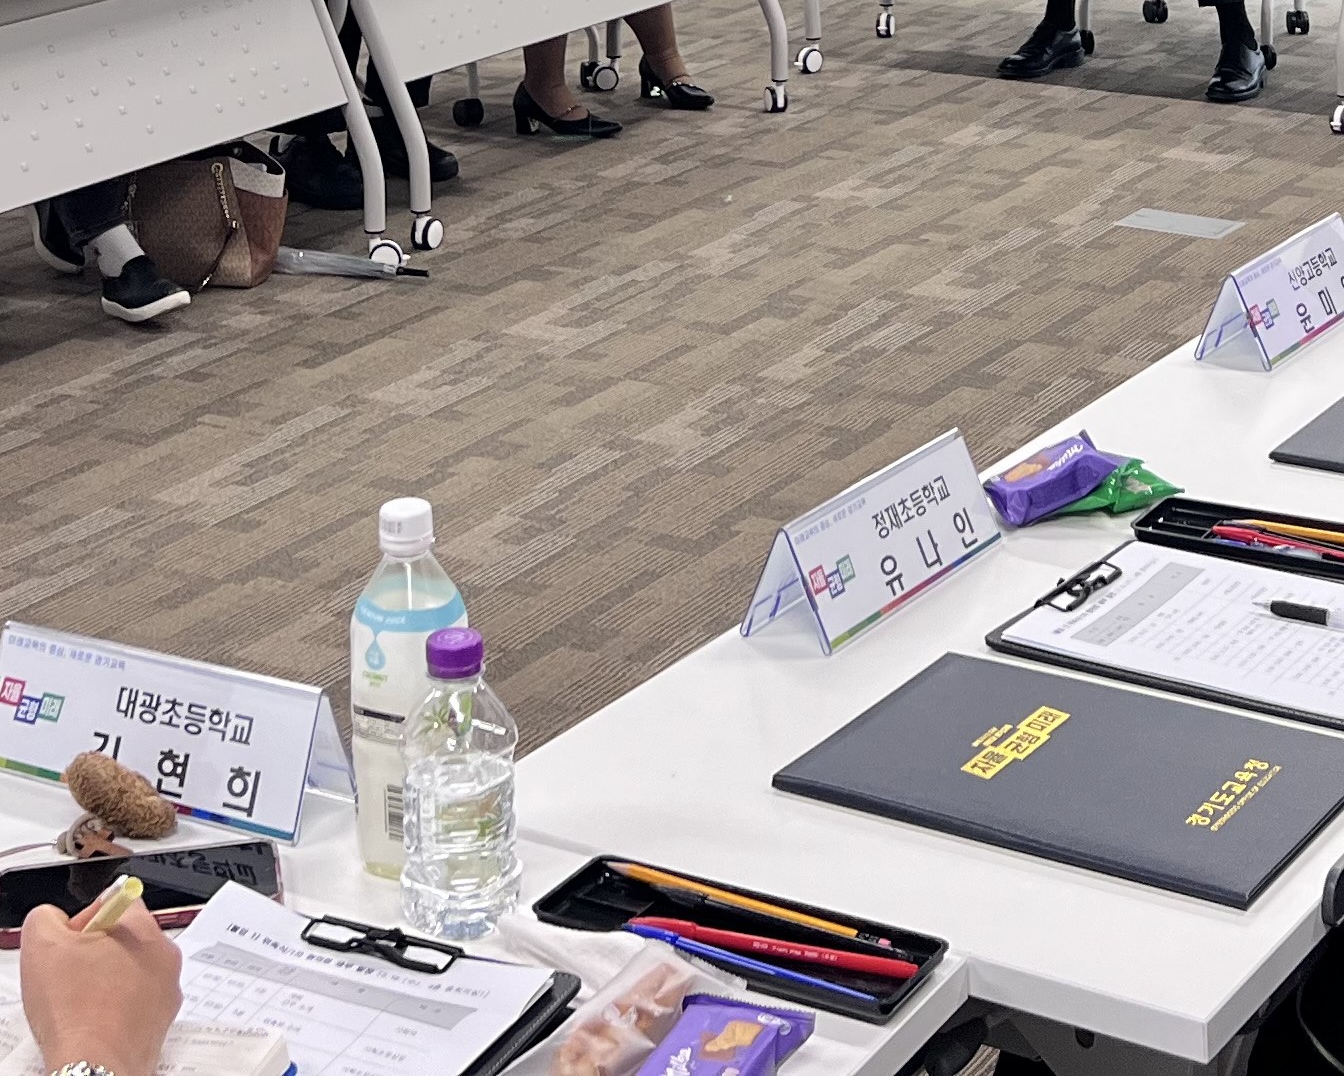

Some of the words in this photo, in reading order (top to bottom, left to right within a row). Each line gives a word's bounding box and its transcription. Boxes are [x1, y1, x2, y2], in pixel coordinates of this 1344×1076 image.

[1296, 303, 1315, 334] 윤
[1317, 286, 1338, 316] 미
[880, 555, 905, 596] 유
[916, 529, 943, 569] 나
[953, 507, 978, 549] 인
[1, 680, 23, 703] 자율
[17, 698, 40, 721] 균형
[39, 696, 62, 719] 미래
[116, 686, 254, 746] 대광초등학교
[970, 750, 1008, 774] 자율
[1004, 731, 1041, 754] 균형
[1026, 711, 1062, 732] 미래
[156, 748, 191, 799] 현
[222, 766, 261, 818] 희
[1185, 759, 1269, 826] 경기도교육청
